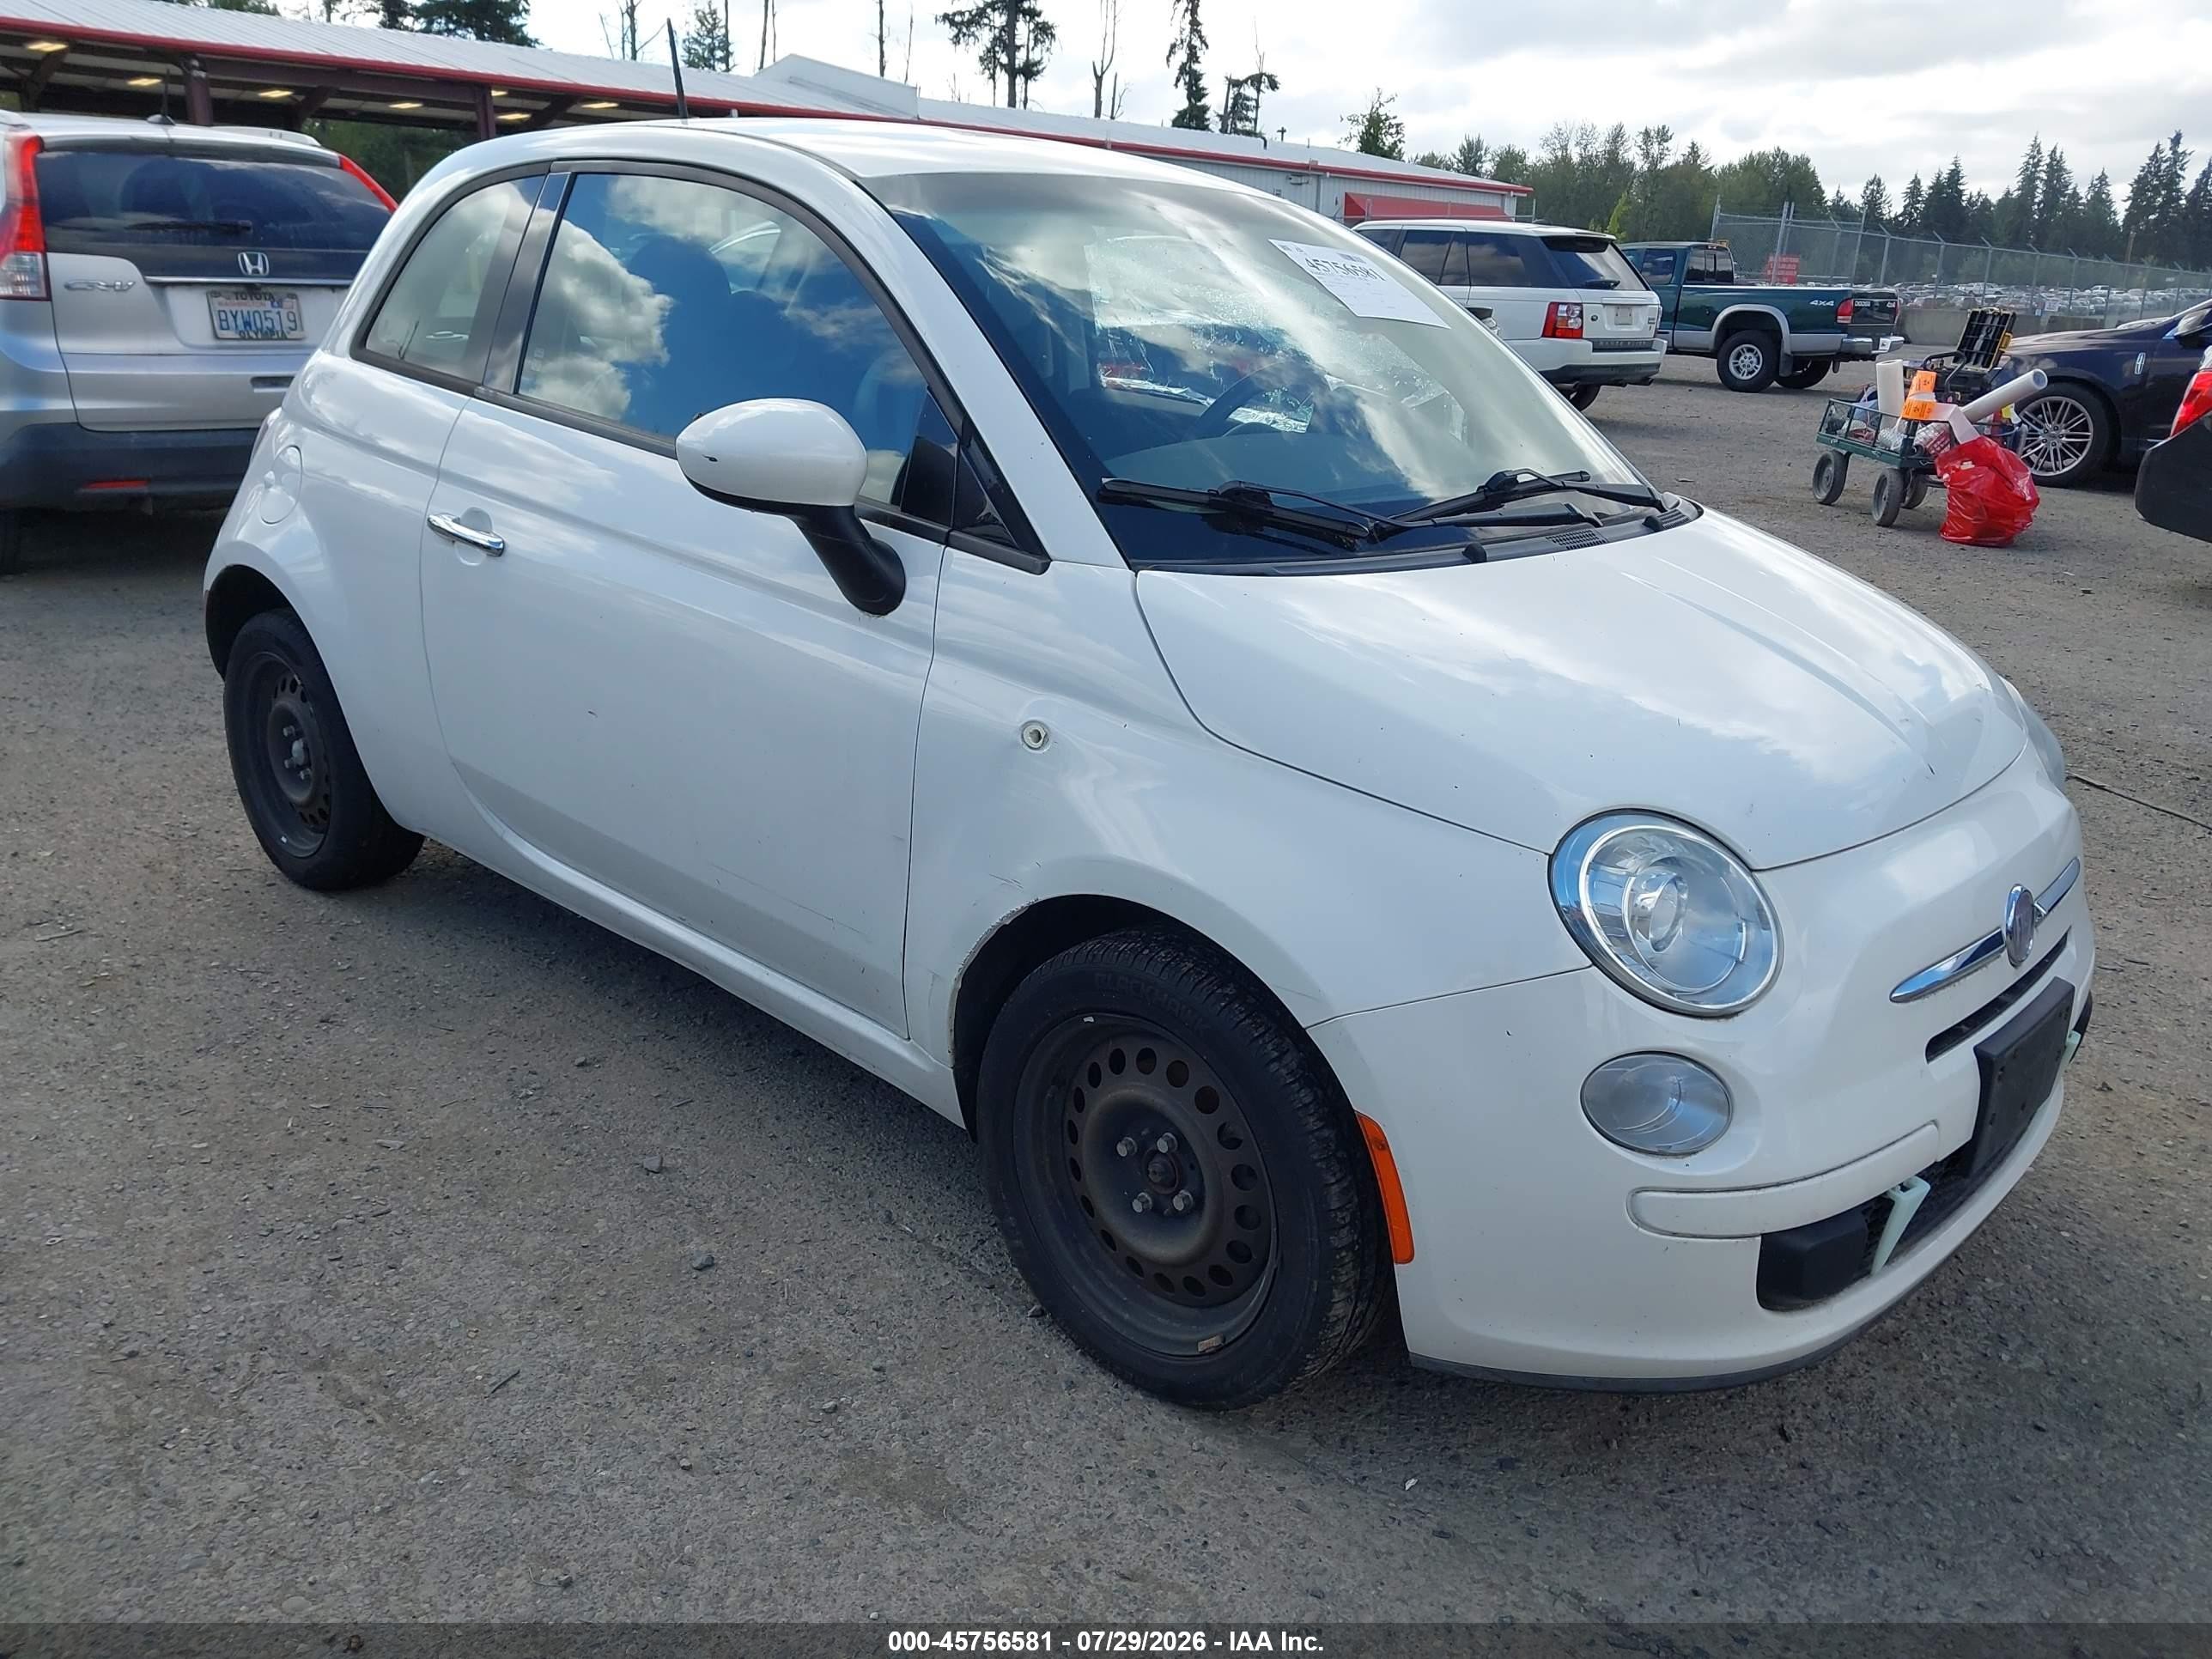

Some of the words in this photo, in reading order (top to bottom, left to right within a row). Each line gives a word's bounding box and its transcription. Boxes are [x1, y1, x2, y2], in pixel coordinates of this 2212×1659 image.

[1304, 258, 1386, 282] 45756581
[64, 280, 135, 292] CR-V
[233, 292, 275, 301] TOYOTA
